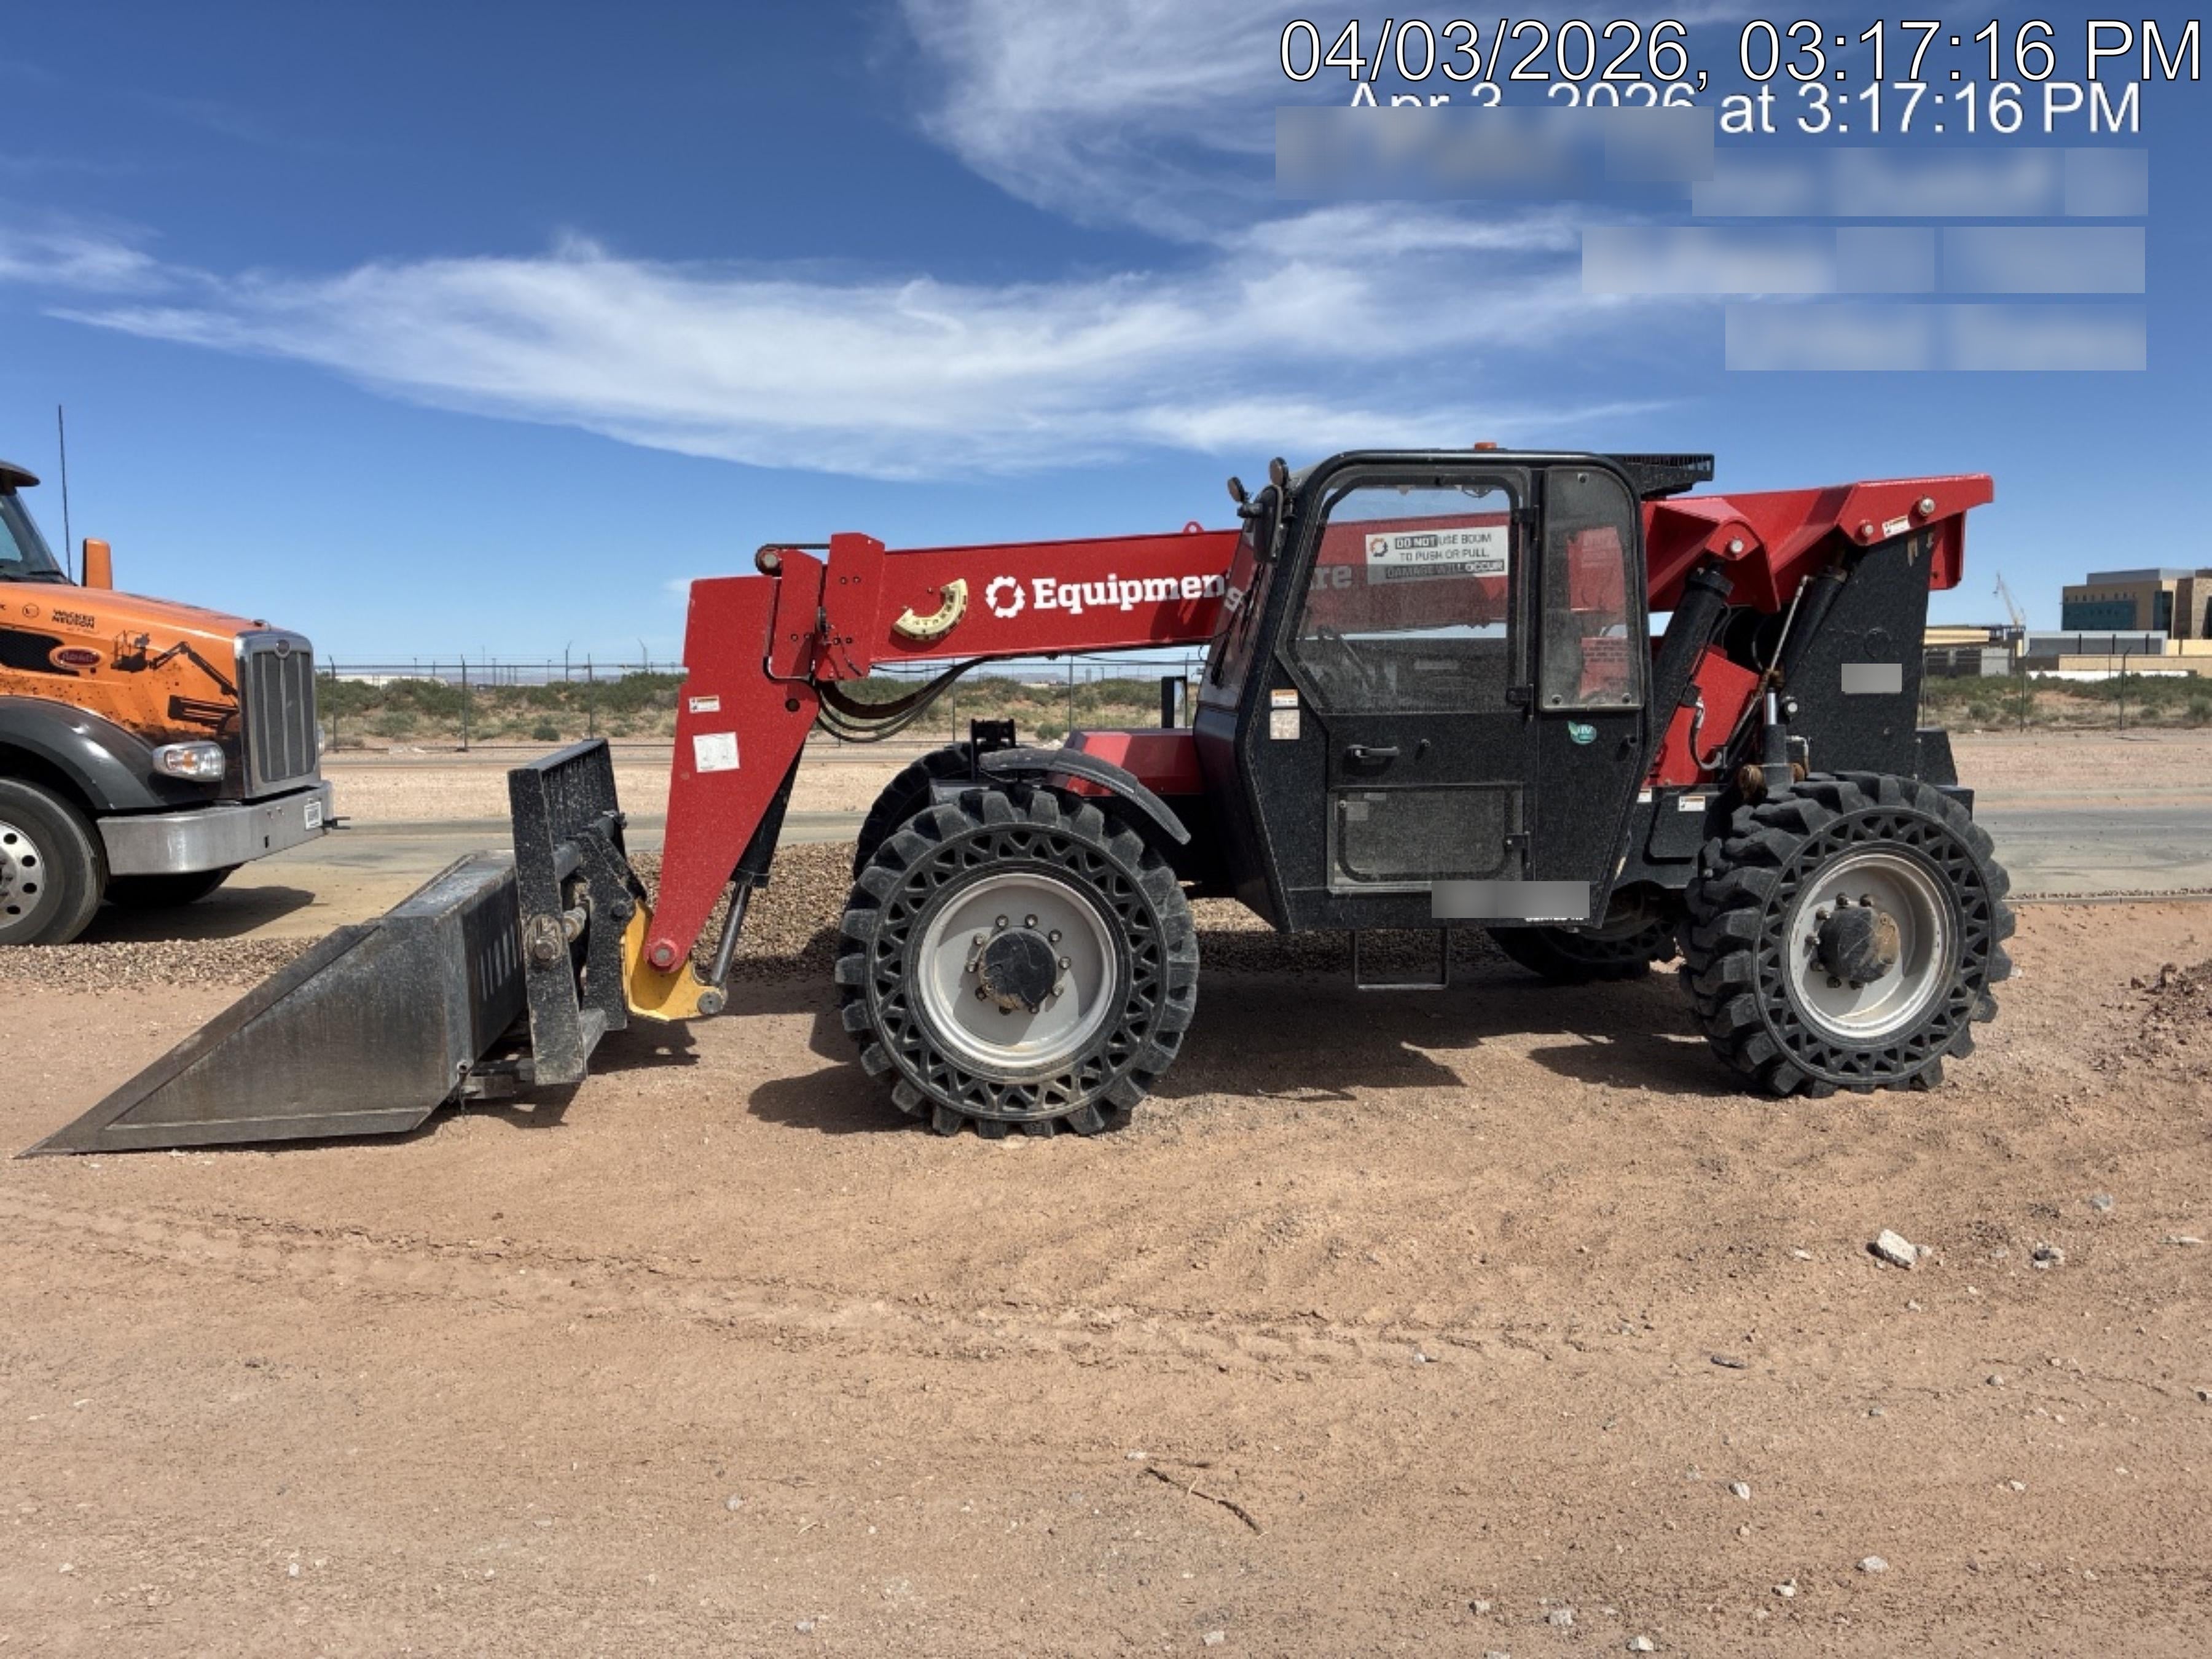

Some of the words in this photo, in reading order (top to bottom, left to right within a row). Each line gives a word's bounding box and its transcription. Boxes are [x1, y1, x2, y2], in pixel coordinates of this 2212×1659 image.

[1397, 538, 1412, 549] DO
[1413, 535, 1437, 548] NOT
[1439, 535, 1458, 546] USE
[1462, 533, 1491, 544] BOOM
[1400, 552, 1412, 562] TO
[1416, 551, 1442, 561] PUSH
[1445, 549, 1461, 559] OR
[1388, 566, 1433, 578] DAMAGE
[1465, 560, 1504, 573] OCCUR
[1031, 569, 1231, 614] Equipmen
